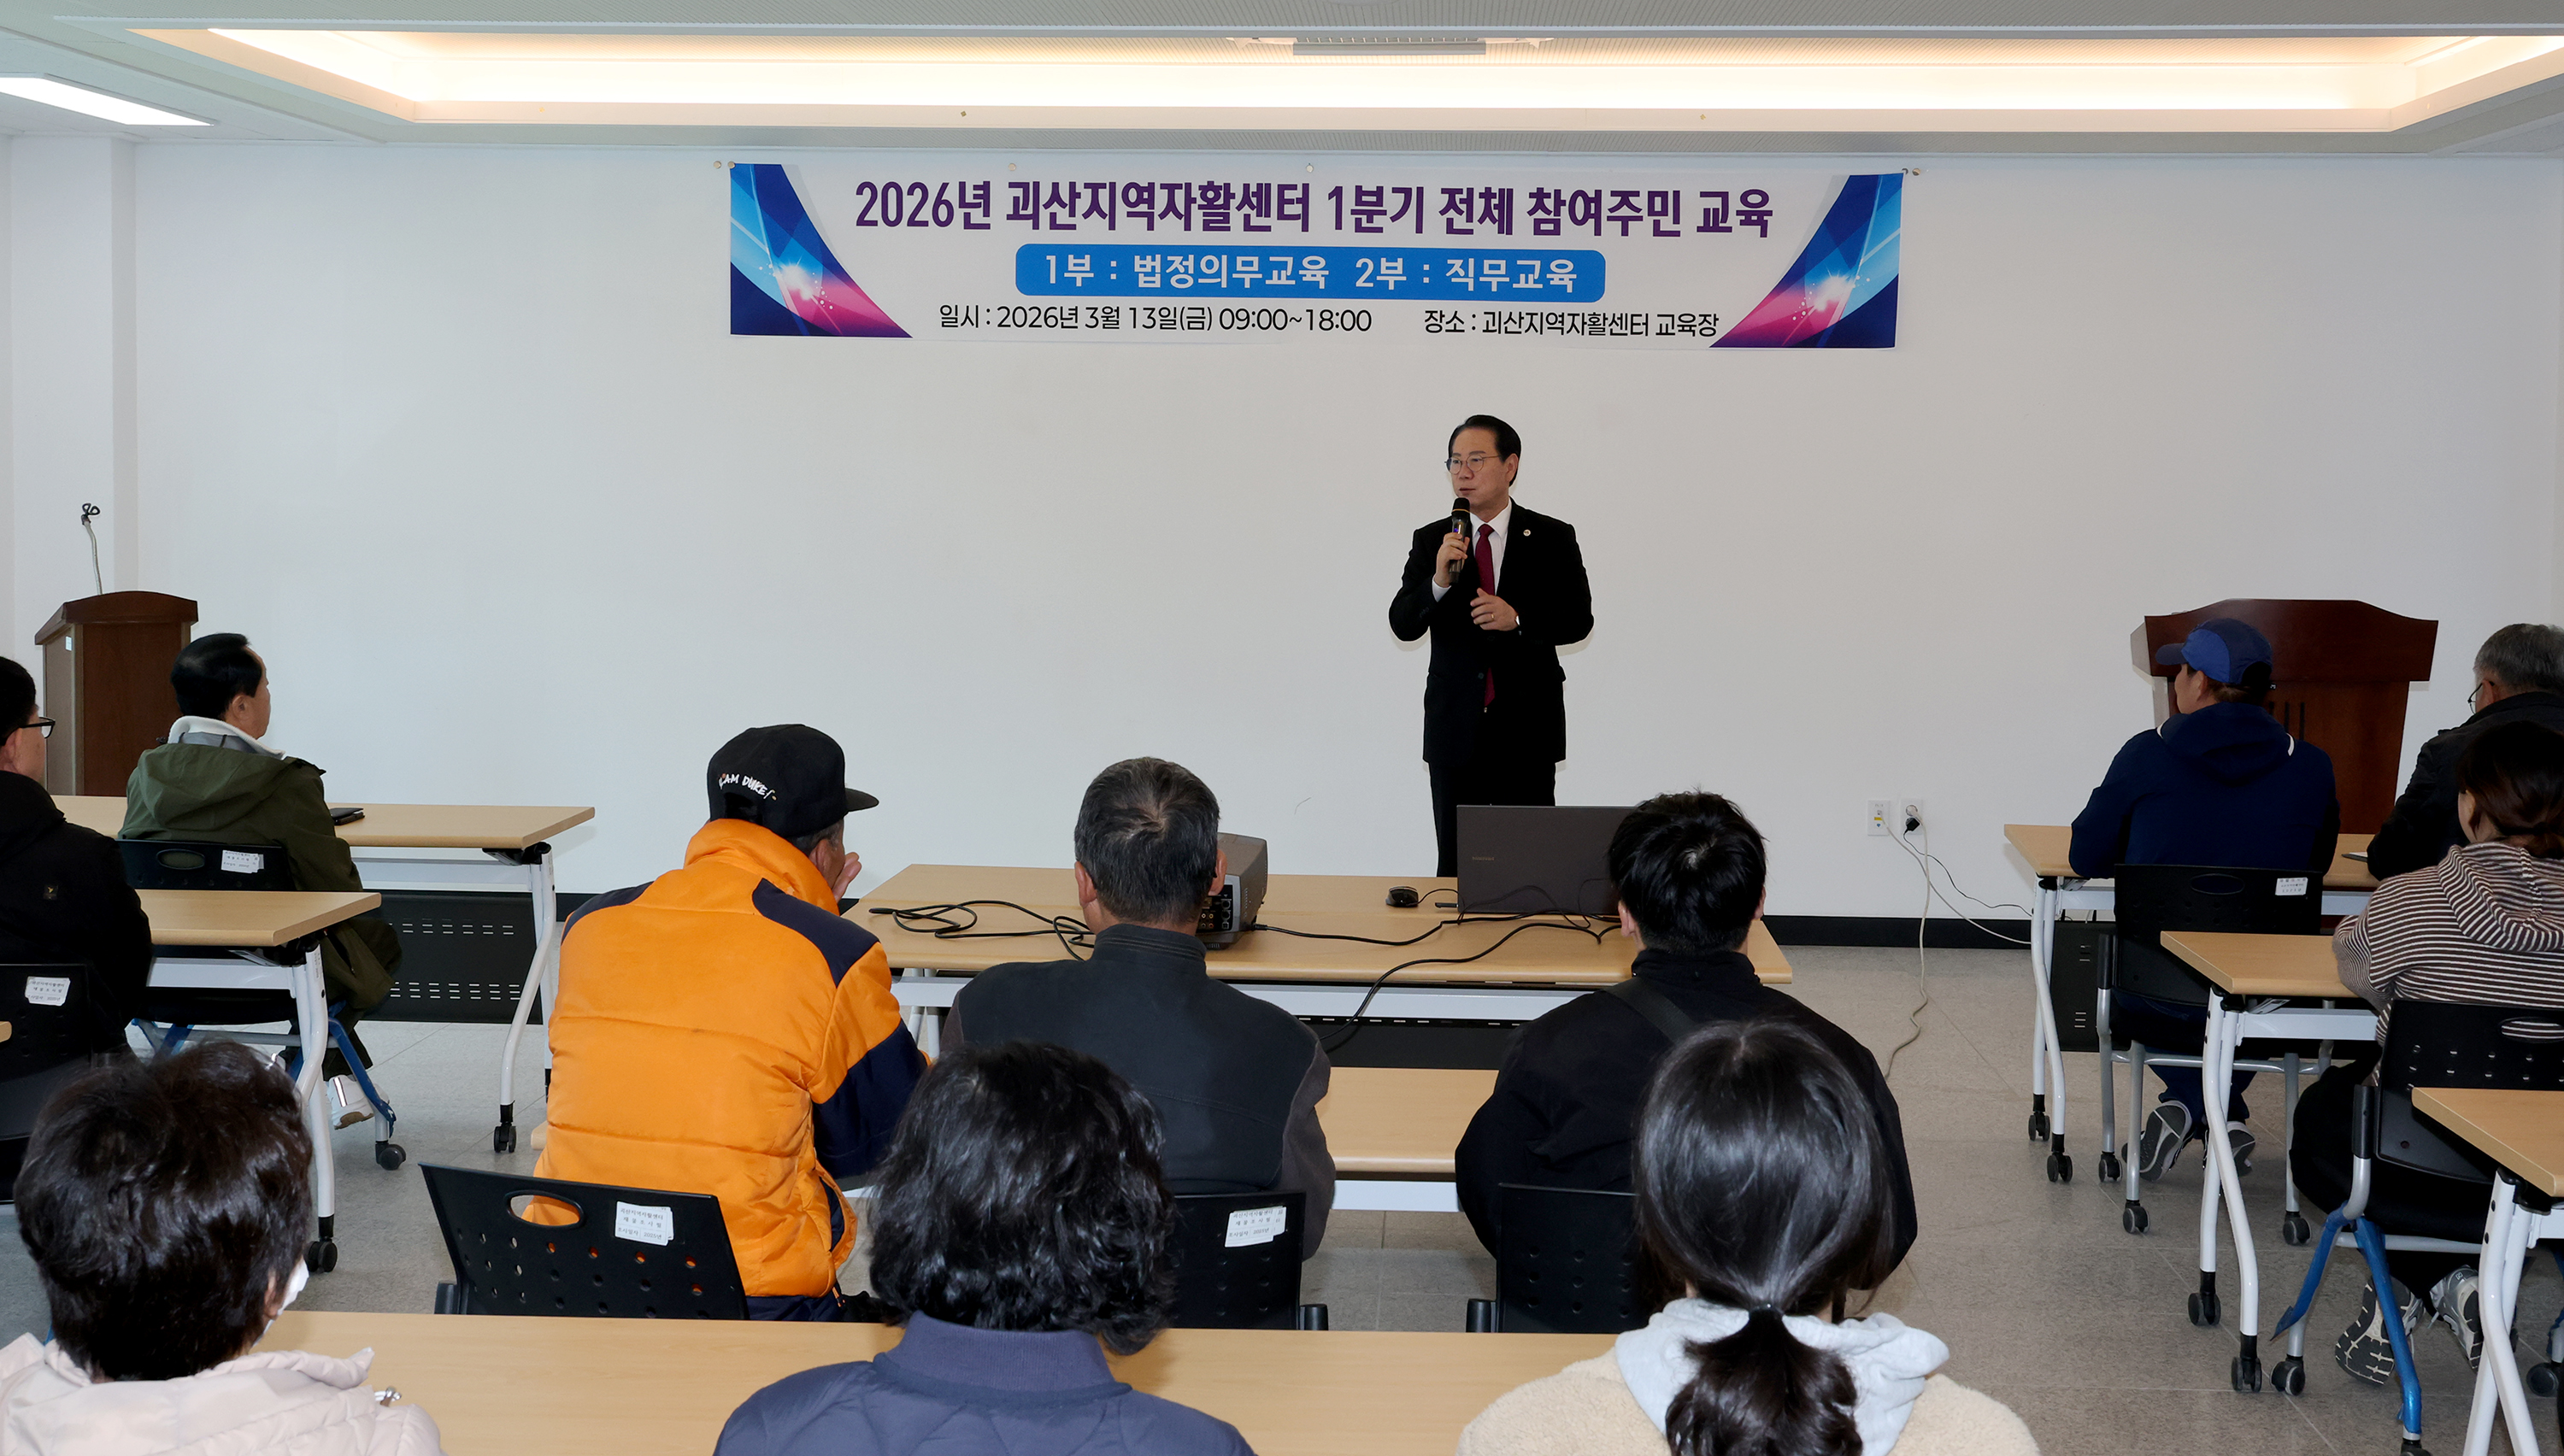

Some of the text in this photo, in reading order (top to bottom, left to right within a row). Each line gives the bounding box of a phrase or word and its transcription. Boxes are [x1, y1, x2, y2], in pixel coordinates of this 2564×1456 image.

[856, 180, 1774, 239] 2026년 괴산지역자활센터 1분기 전체 참여주민 교육
[1045, 254, 1095, 287] 1부
[1133, 254, 1330, 291] 법정의무교육
[1355, 256, 1408, 291] 2부
[1445, 258, 1578, 294] 직무교육
[939, 304, 979, 330] 일시
[997, 305, 1079, 330] 2026년
[1085, 306, 1120, 331] 3월
[1128, 306, 1214, 332] 13일(금)
[1219, 308, 1373, 332] 09:00~18:00
[1424, 309, 1467, 335] 장소
[1482, 310, 1650, 337] 괴산지역자활센터
[1655, 313, 1720, 338] 교육장
